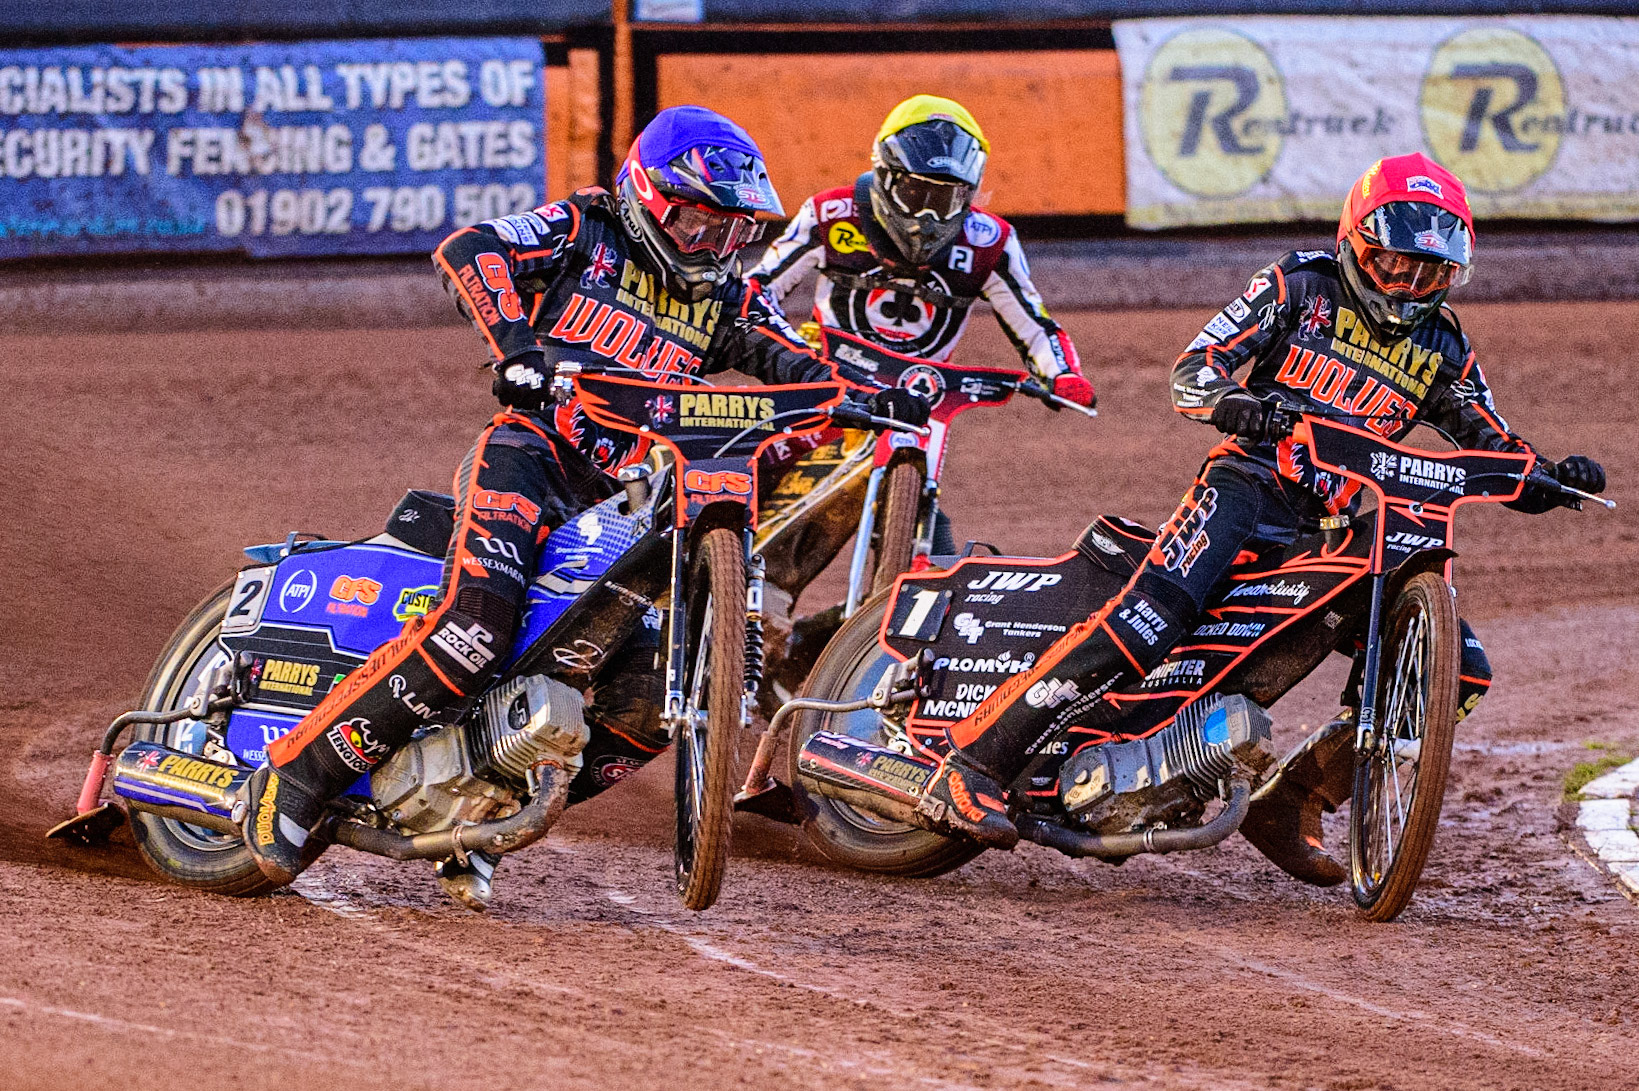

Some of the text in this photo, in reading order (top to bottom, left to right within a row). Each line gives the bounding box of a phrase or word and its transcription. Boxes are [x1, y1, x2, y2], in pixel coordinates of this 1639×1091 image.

[200, 67, 244, 113] IN
[255, 64, 333, 112] ALL
[336, 61, 470, 110] TYPES
[481, 60, 535, 107] OF
[360, 124, 395, 173] &
[408, 121, 536, 171] GATES
[216, 190, 353, 237] 01902
[363, 187, 444, 233] 790
[954, 249, 967, 271] 2
[458, 264, 501, 326] FILTRATION
[680, 393, 775, 420] PARRYS
[1400, 456, 1466, 486] PARRYS
[1385, 531, 1445, 549] JWP
[1386, 543, 1412, 553] racing
[285, 584, 311, 598] ATPI
[966, 571, 1063, 592] JWP
[229, 580, 264, 618] 2
[964, 591, 1005, 605] racing
[899, 588, 939, 637] 1
[1133, 599, 1169, 633] Harry
[984, 620, 1067, 633] Grant Henderson
[1003, 628, 1042, 638] Tankers
[1119, 608, 1159, 646] & Jules
[1193, 621, 1266, 638] OCKED DOWN
[439, 627, 489, 669] ROCK OIL
[262, 659, 320, 687] PARRYS
[1140, 676, 1202, 688] AUSTRALIA
[258, 680, 314, 696] INTERNATIONAL
[923, 699, 982, 718] MCNI
[243, 749, 268, 762] WESSE
[873, 755, 931, 783] PARRYS
[158, 754, 240, 789] PARRYS
